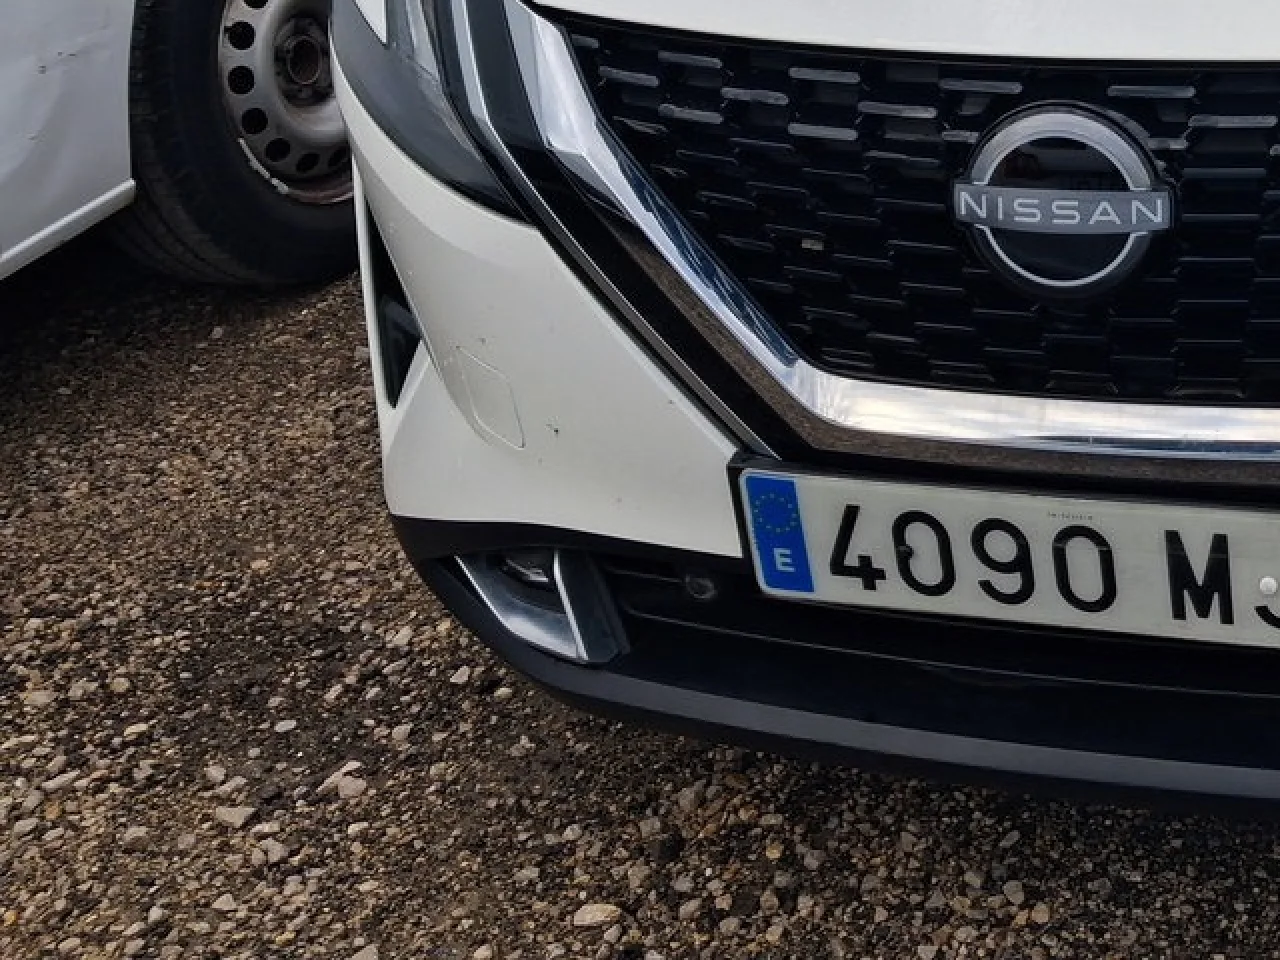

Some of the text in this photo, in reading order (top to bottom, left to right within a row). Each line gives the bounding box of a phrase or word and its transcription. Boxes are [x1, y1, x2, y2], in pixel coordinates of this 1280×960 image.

[959, 191, 1163, 225] NISSAN
[774, 546, 796, 573] E
[829, 503, 1117, 613] 4090
